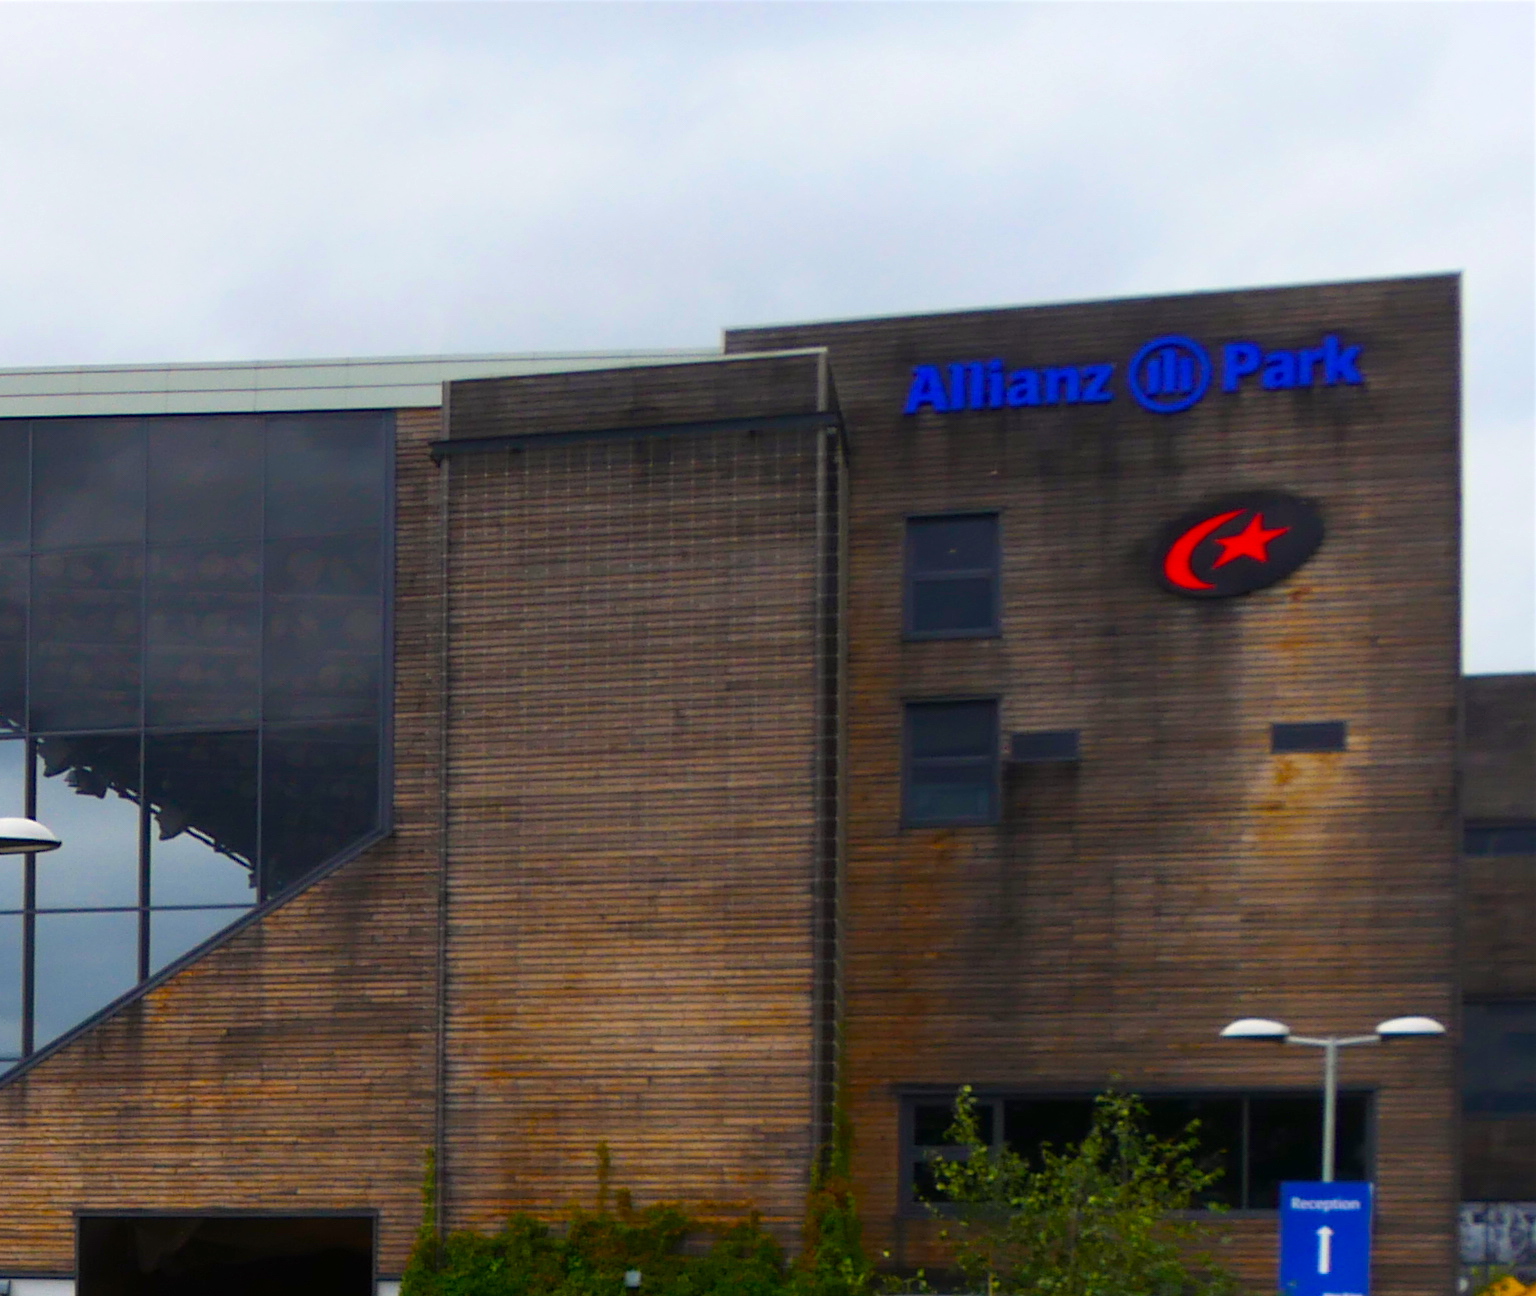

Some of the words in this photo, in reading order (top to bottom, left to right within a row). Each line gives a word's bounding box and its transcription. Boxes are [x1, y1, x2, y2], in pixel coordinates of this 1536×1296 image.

[902, 358, 1116, 415] Allianz
[1221, 333, 1365, 393] Park
[1290, 1196, 1362, 1212] Reception
